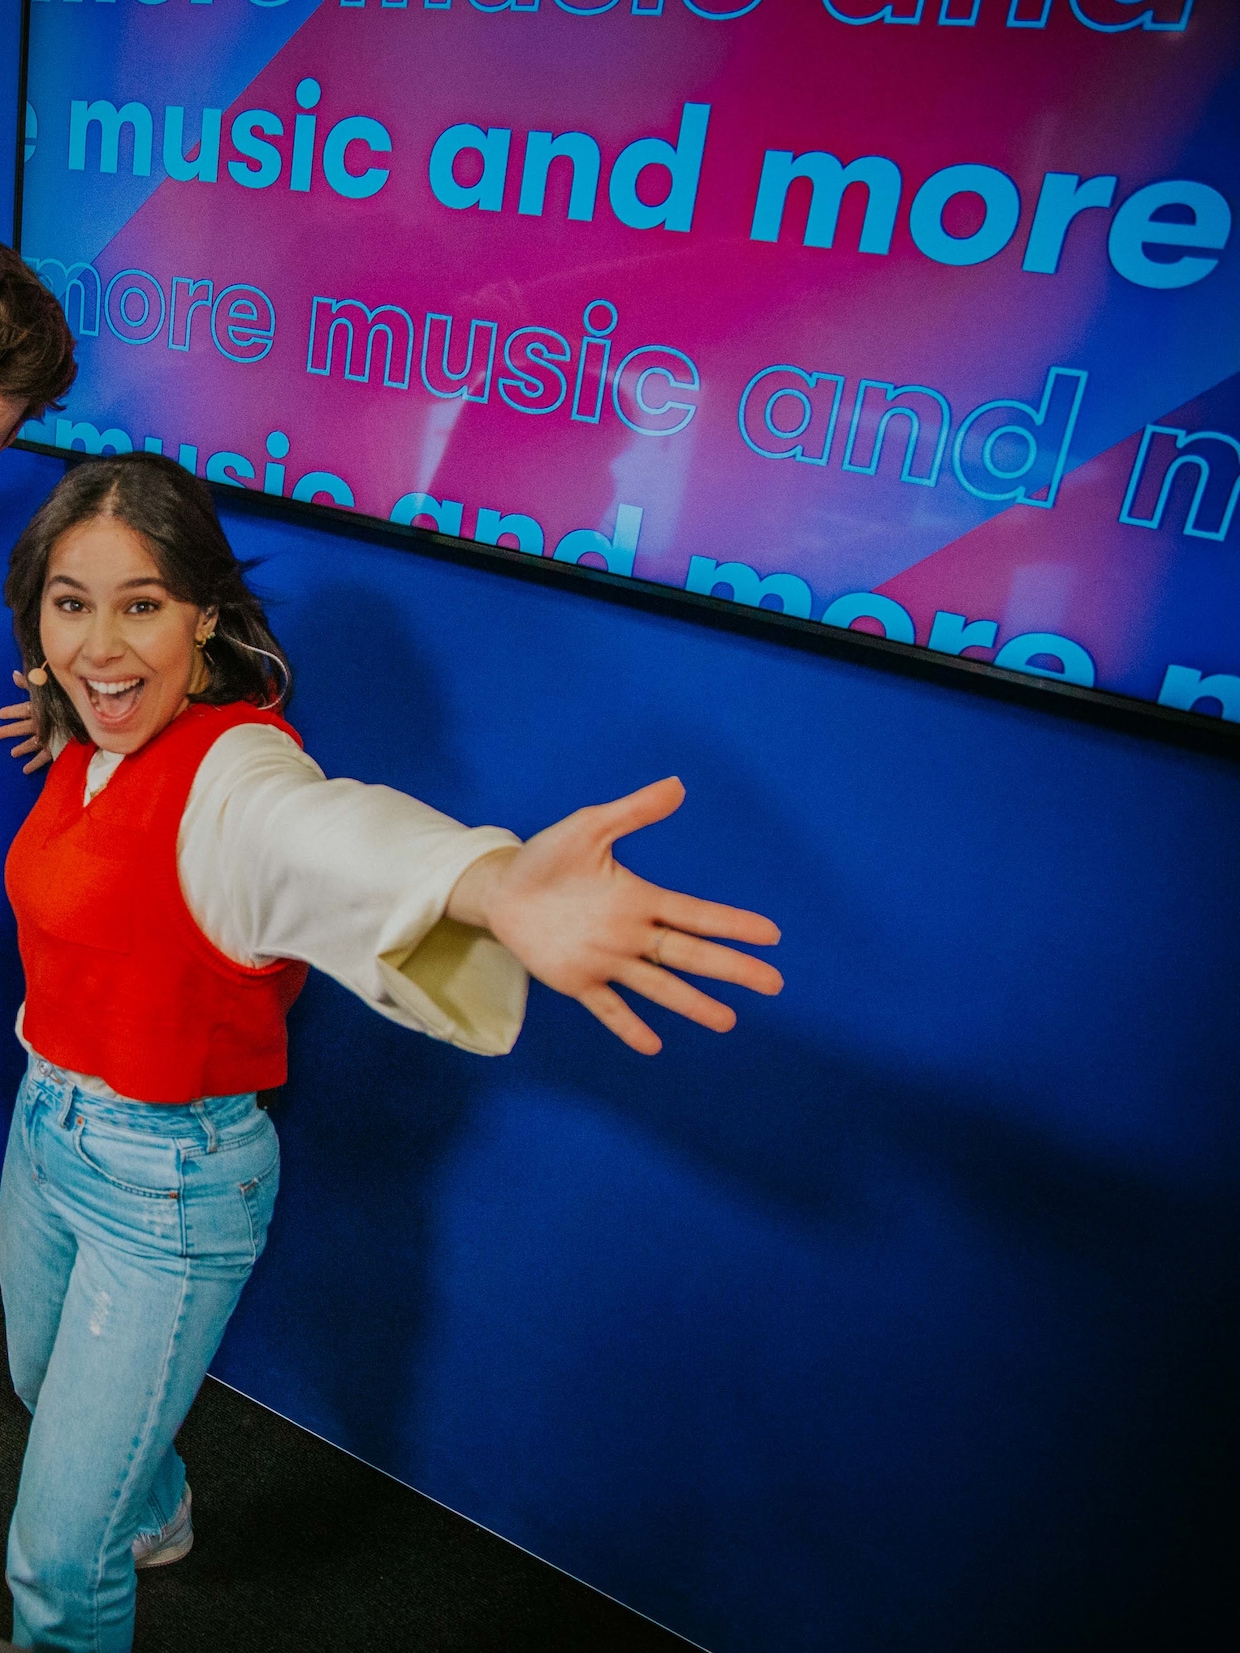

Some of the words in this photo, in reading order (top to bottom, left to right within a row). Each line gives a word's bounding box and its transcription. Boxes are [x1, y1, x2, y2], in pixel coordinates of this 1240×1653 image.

[68, 77, 393, 199] music
[429, 102, 711, 233] and
[750, 149, 1231, 290] more
[22, 256, 276, 364] more
[306, 296, 700, 436] music
[738, 364, 1088, 508] and
